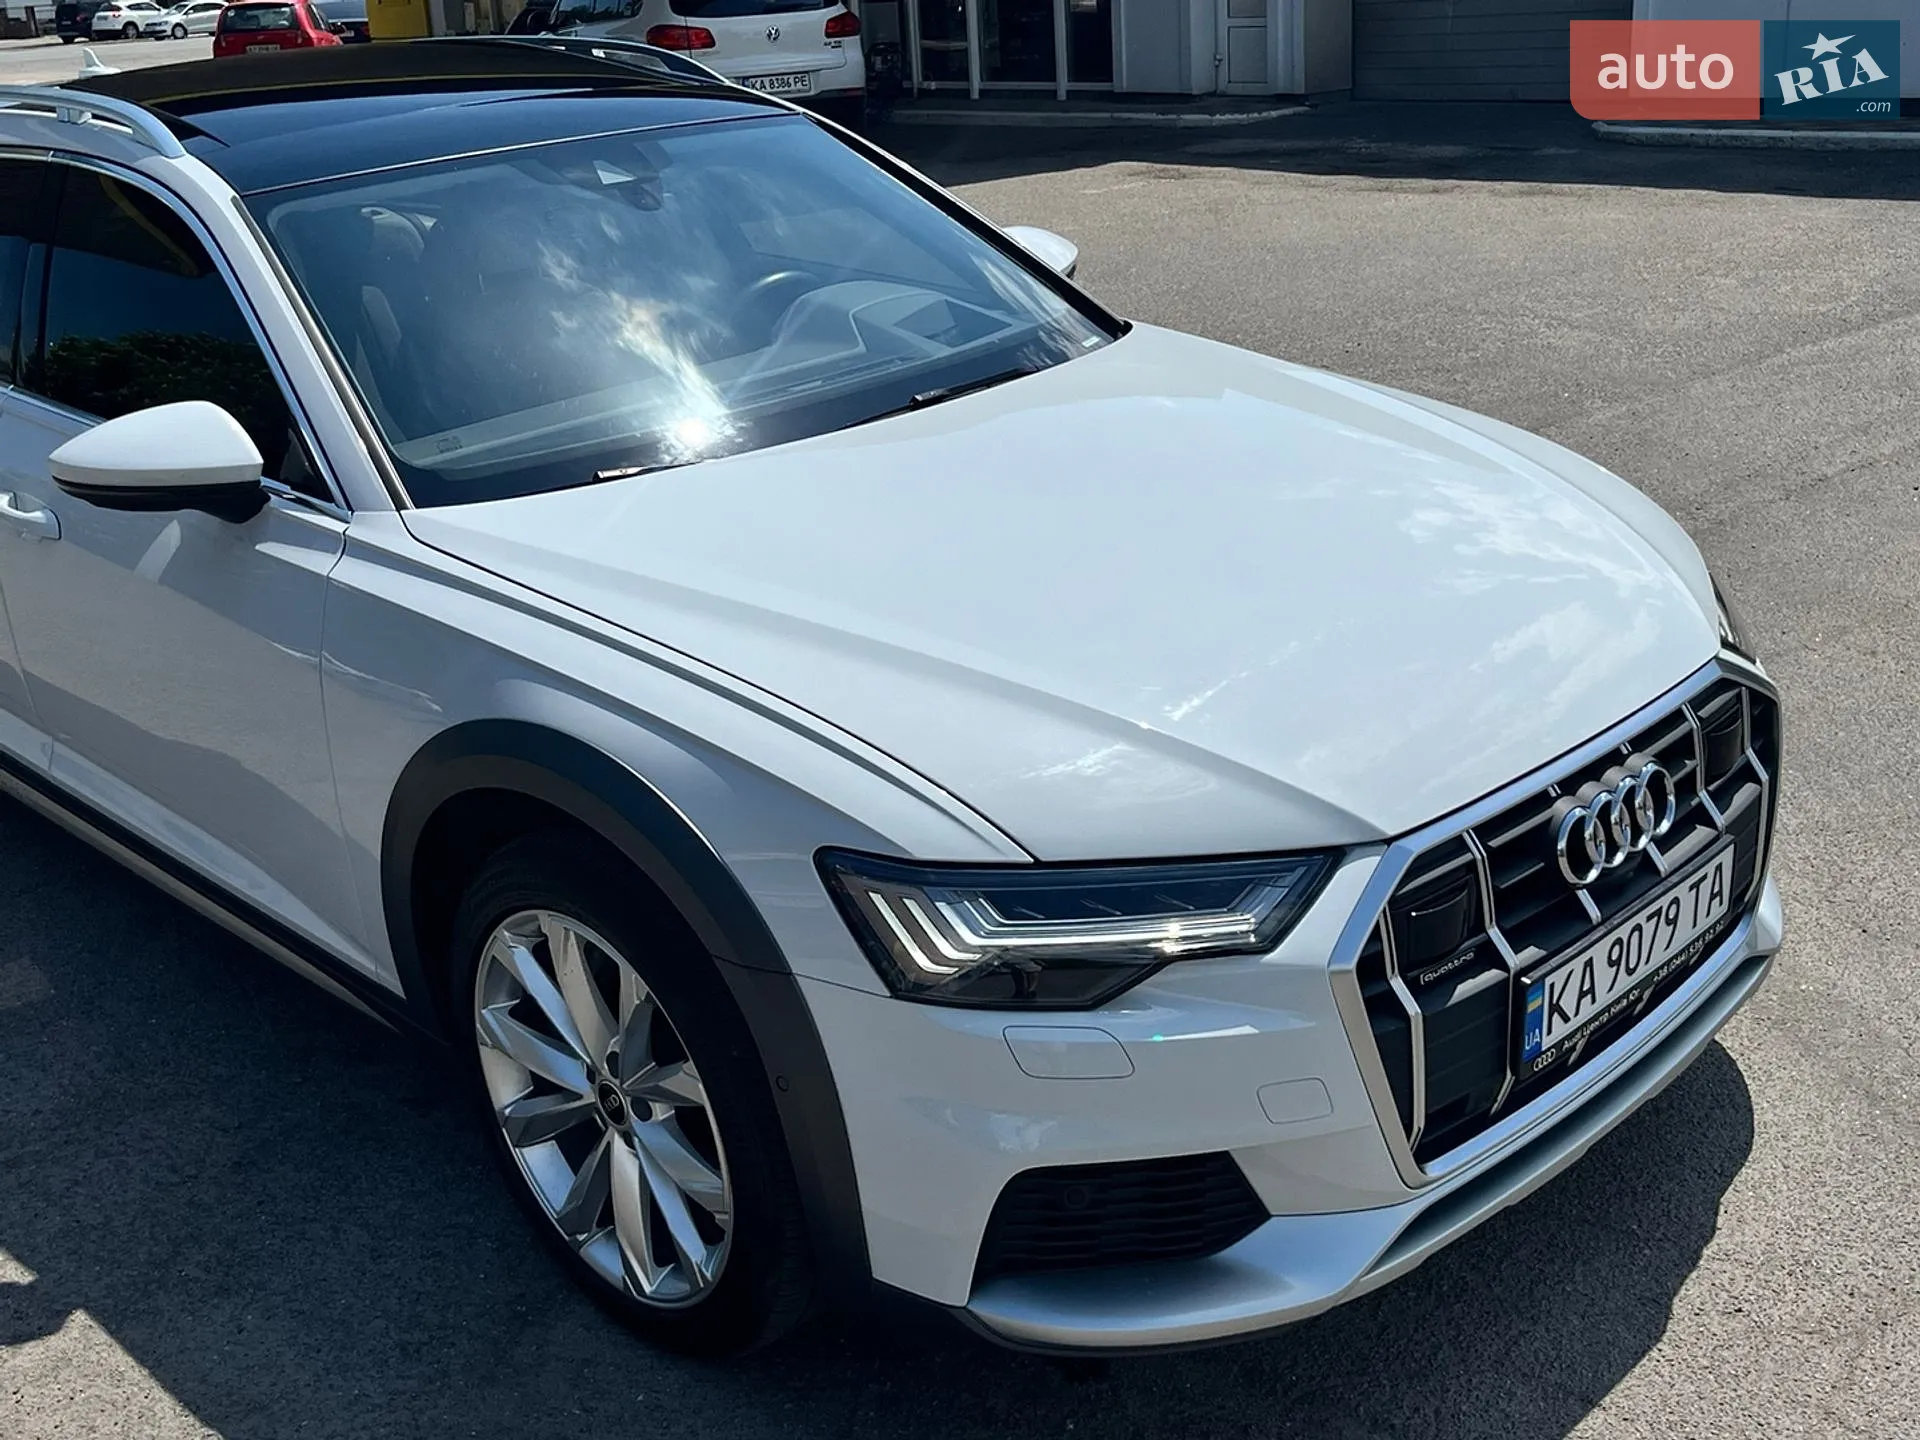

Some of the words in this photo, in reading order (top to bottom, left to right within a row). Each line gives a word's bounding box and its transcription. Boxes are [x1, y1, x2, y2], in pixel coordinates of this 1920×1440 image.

[750, 79, 766, 91] KA
[769, 77, 792, 90] 8386
[793, 75, 808, 87] PE
[1546, 957, 1597, 1037] KA
[1606, 896, 1681, 994] 9079
[1688, 862, 1724, 929] TA
[1421, 951, 1475, 985] quattro
[1524, 1028, 1541, 1050] UA
